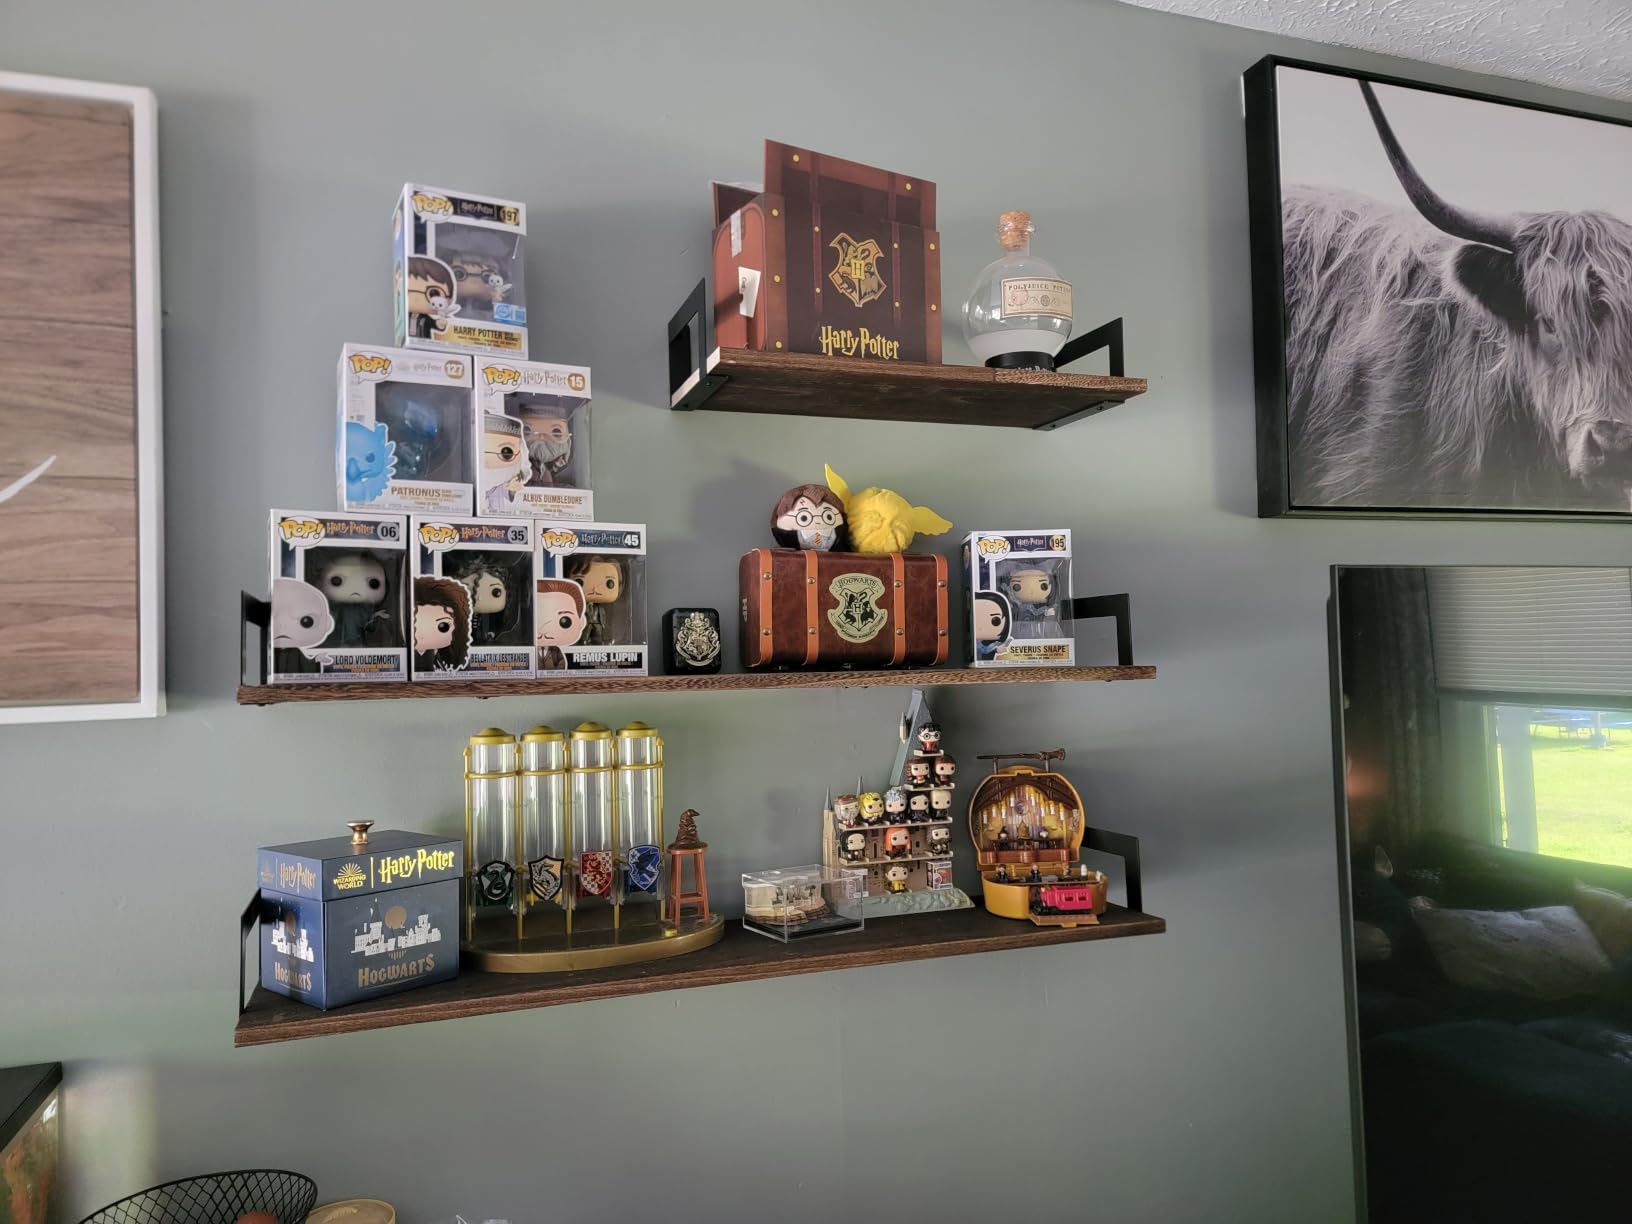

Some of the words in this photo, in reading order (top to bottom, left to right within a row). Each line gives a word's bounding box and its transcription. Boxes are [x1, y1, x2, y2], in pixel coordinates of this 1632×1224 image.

[411, 193, 453, 216] POP!
[502, 209, 518, 222] 197
[453, 326, 476, 336] HARRY
[478, 329, 502, 340] POTTER
[819, 326, 859, 356] Harry
[859, 328, 899, 359] Potter
[350, 354, 392, 375] POP!
[483, 367, 521, 386] POP!
[570, 376, 584, 388] 15
[391, 487, 440, 497] PATRONUS
[523, 494, 542, 503] ALBUS
[543, 495, 583, 505] DUMBLEDORE
[279, 520, 324, 540] POP!
[326, 522, 350, 535] Harry
[350, 522, 375, 535] Potter
[381, 526, 397, 538] 06
[461, 526, 483, 540] Harry
[483, 526, 506, 539] Potter
[419, 526, 458, 544] POP!
[511, 530, 525, 542] 35
[542, 530, 577, 549] POP!
[624, 534, 639, 546] 45
[976, 538, 1009, 556] POP!
[1051, 538, 1065, 548] 195
[838, 577, 878, 589] HOGWARTS
[1010, 645, 1042, 654] SEVERUS
[1043, 645, 1066, 653] SNAPE
[335, 655, 353, 665] LORD
[355, 655, 395, 665] VOLDEMORT
[470, 653, 498, 663] BELLATRIX
[499, 653, 528, 663] LESTRANGE
[573, 652, 608, 662] REMUS
[610, 652, 638, 662] LUPIN
[378, 856, 417, 884] Harry
[417, 848, 455, 879] Potter
[280, 862, 297, 888] Harry
[297, 862, 317, 896] Potter
[333, 874, 367, 885] WIZARDING
[337, 880, 364, 890] WORLD
